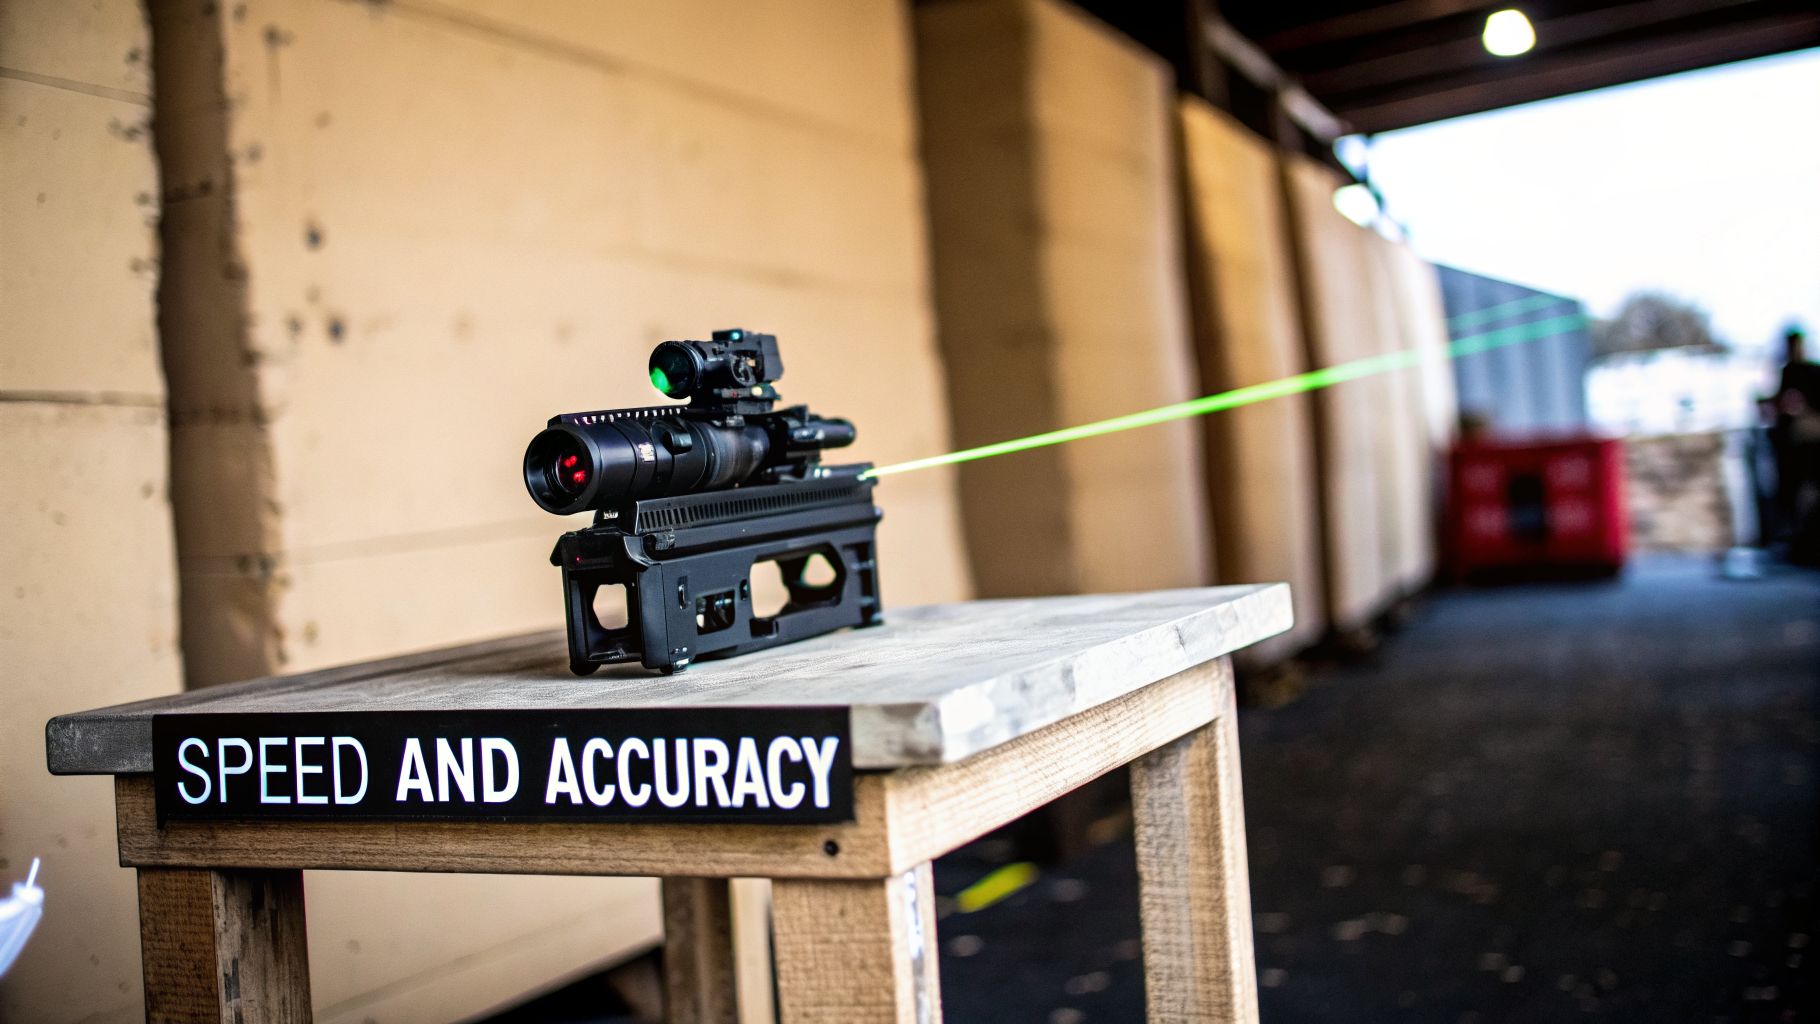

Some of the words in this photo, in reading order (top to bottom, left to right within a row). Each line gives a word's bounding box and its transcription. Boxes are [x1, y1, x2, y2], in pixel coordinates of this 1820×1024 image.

[177, 736, 369, 805] SPEED
[395, 737, 520, 803] AND
[545, 736, 840, 809] ACCURACY
